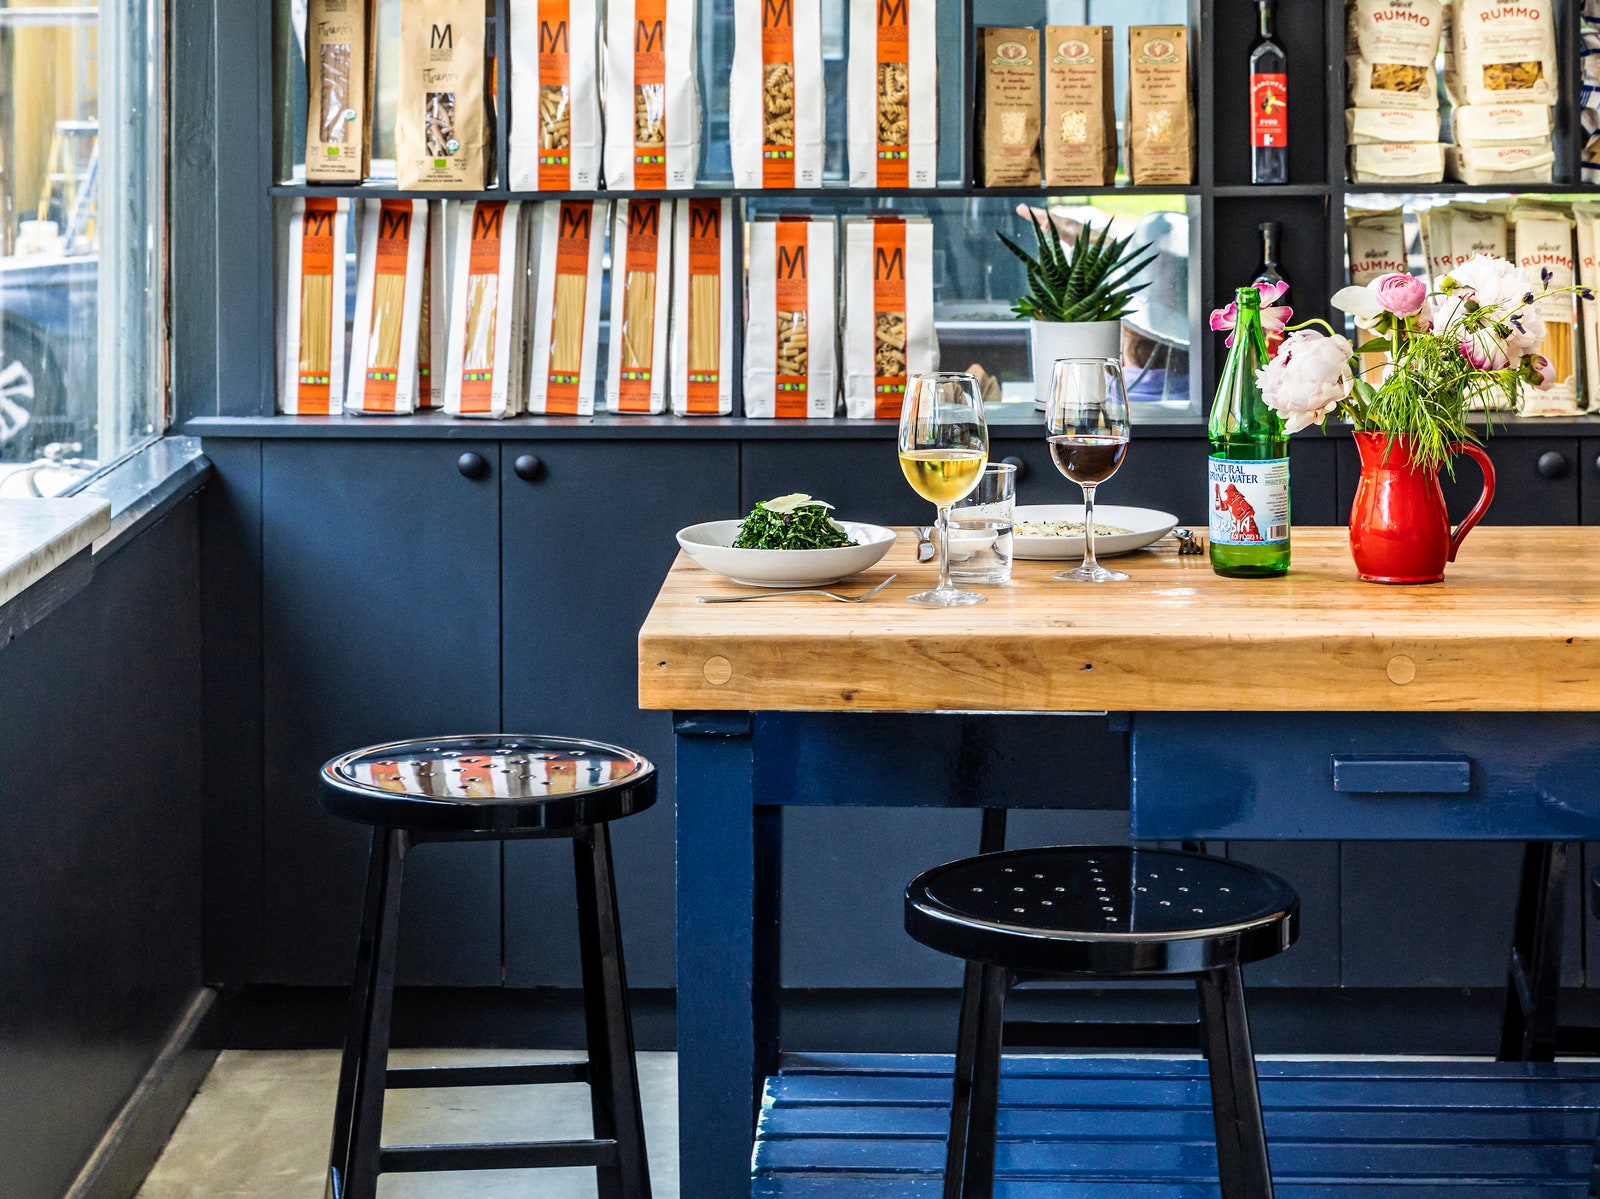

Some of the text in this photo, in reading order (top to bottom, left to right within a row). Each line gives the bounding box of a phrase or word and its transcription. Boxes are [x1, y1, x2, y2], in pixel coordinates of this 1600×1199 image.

[1373, 10, 1430, 28] RUMMO
[1480, 7, 1540, 24] RUMMO
[430, 24, 453, 49] M
[540, 21, 569, 53] M
[636, 20, 664, 53] M
[1380, 110, 1414, 119] RUMMO
[1488, 108, 1523, 117] RUMMO
[1382, 144, 1417, 153] RUMMO
[1497, 148, 1532, 158] RUMMO
[304, 211, 333, 237] M
[379, 210, 409, 240] M
[473, 209, 500, 240] M
[559, 207, 589, 239] M
[628, 205, 657, 236] M
[691, 208, 719, 238] M
[777, 246, 807, 280] M
[875, 247, 905, 280] M
[1213, 463, 1246, 475] NATURAL
[1228, 474, 1259, 484] WATER
